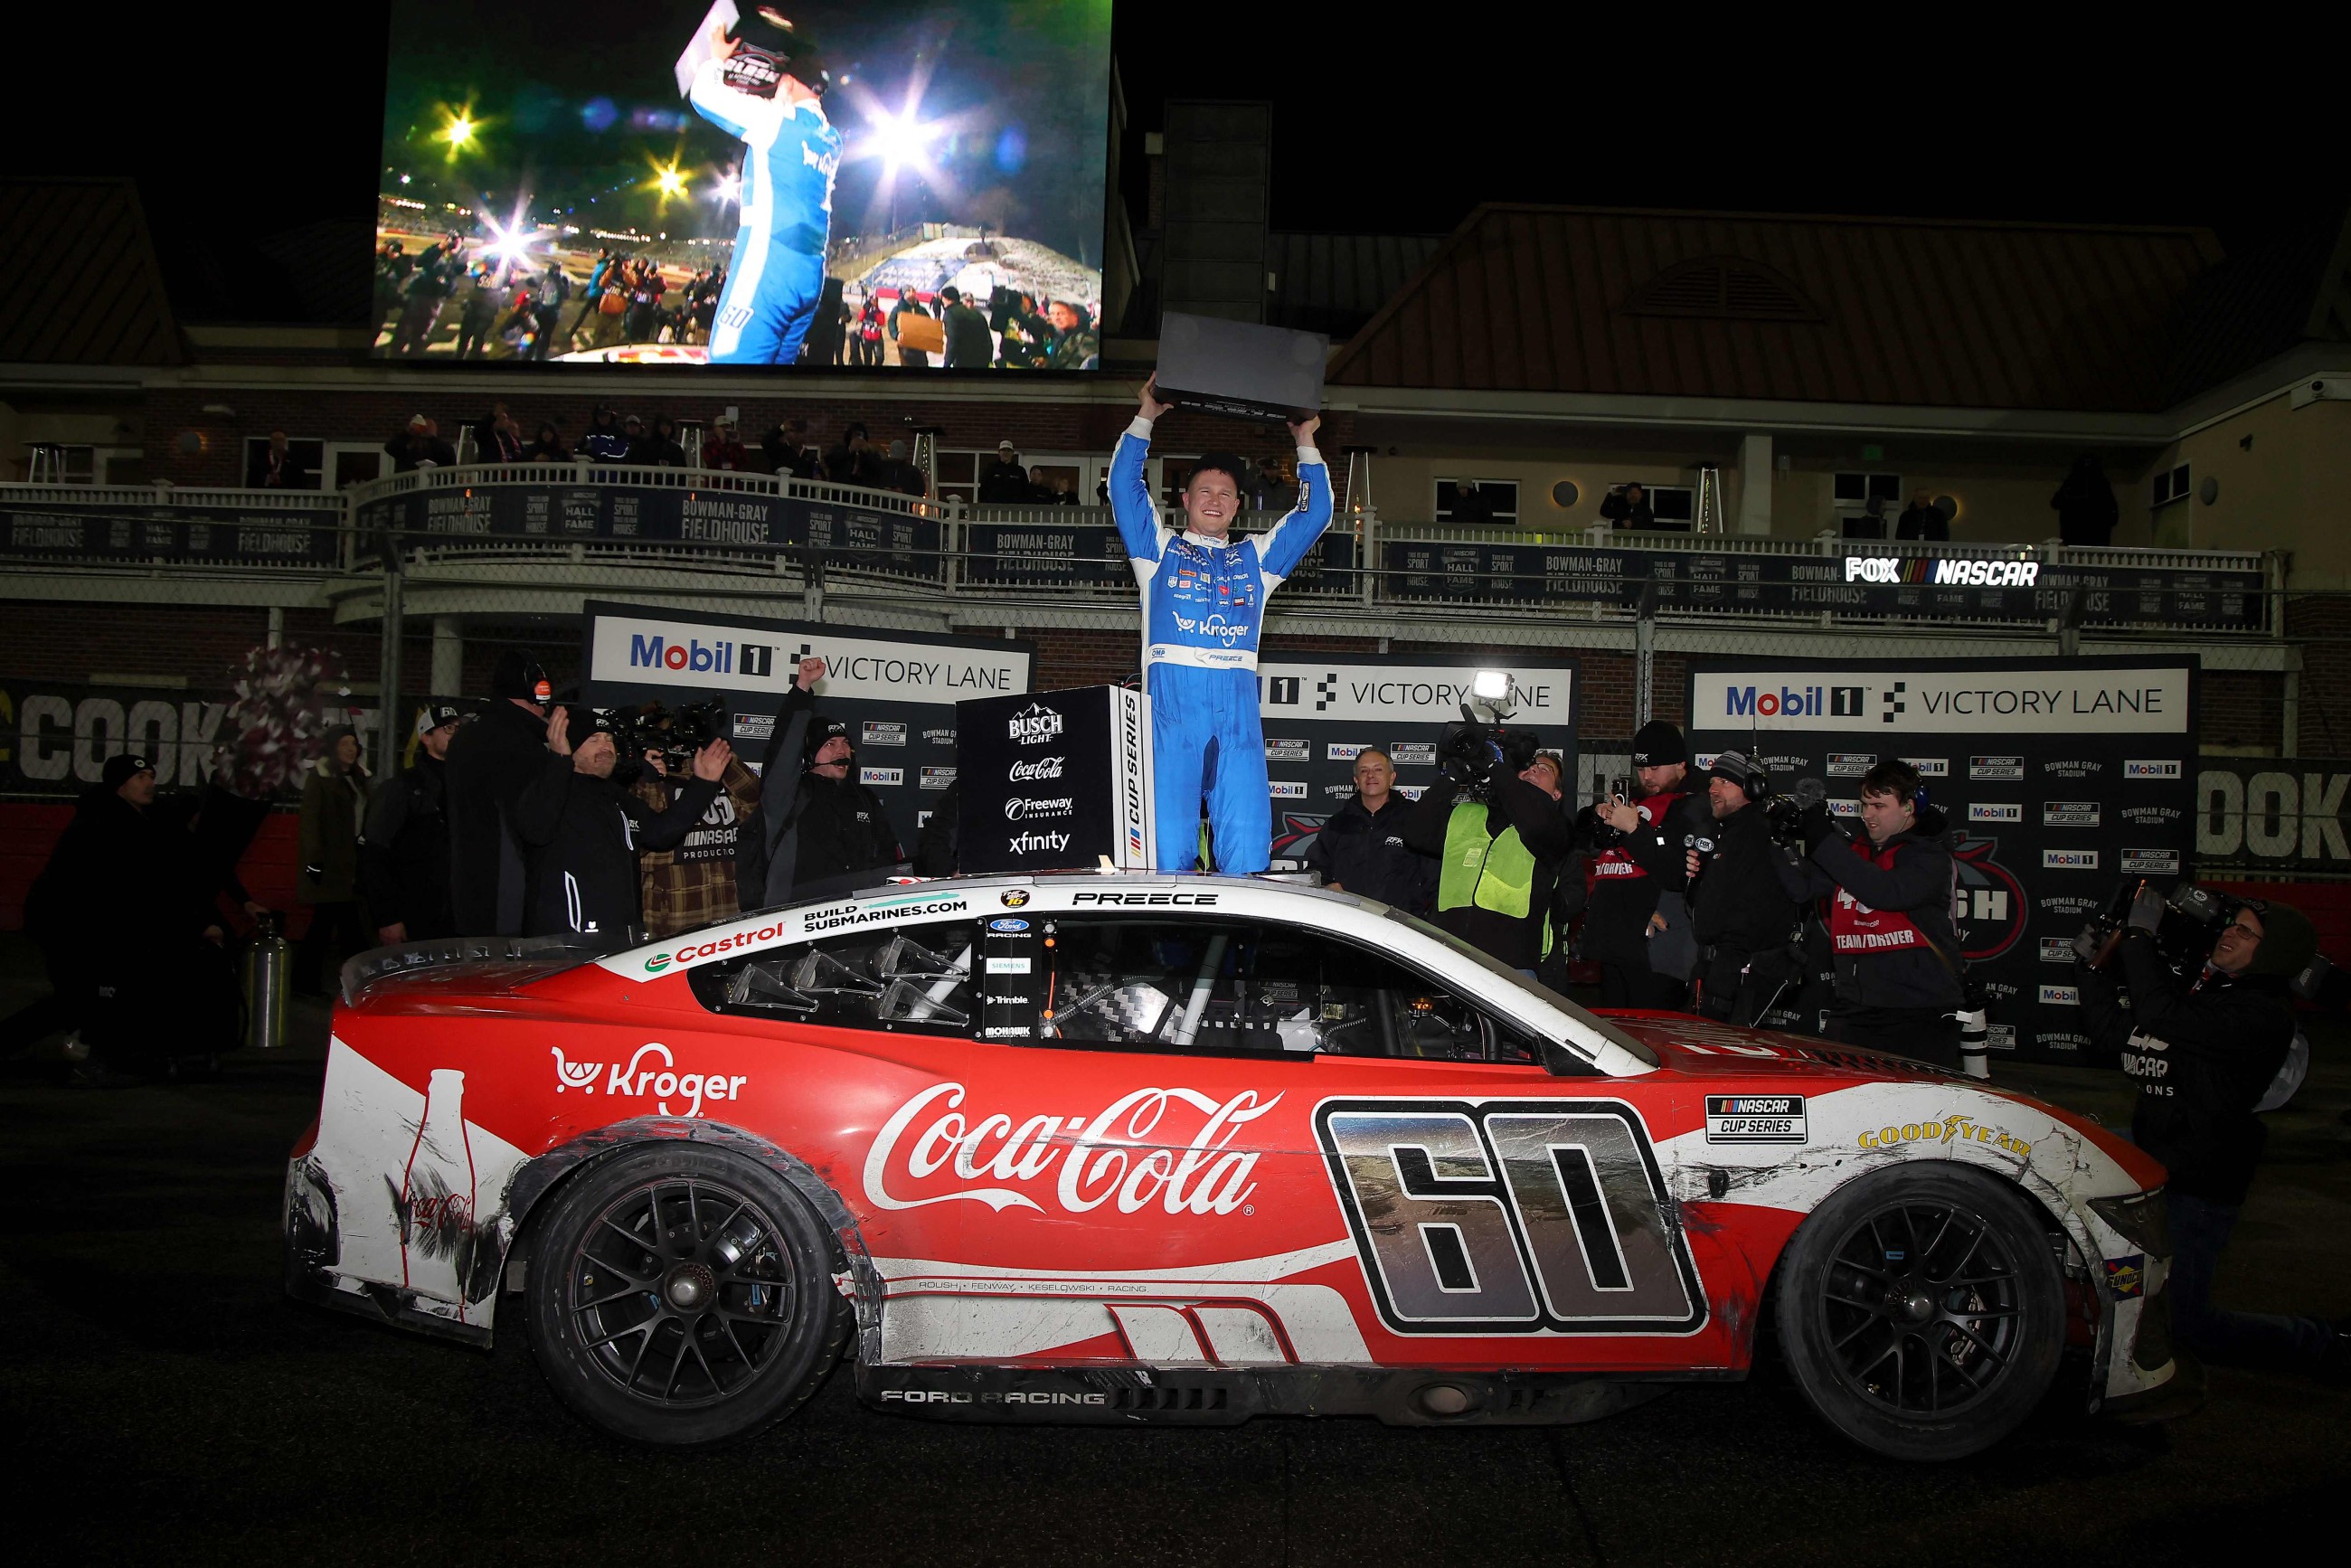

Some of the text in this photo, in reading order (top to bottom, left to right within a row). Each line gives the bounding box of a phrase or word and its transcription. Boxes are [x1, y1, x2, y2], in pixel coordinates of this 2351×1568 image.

[724, 58, 779, 83] CLASH
[427, 494, 491, 515] BOWMAN-GRAY
[614, 504, 637, 515] SPORT
[565, 506, 595, 516] HALL
[682, 499, 769, 522] BOWMAN-GRAY
[427, 514, 491, 534] FIELDHOUSE
[564, 520, 594, 530] FAME
[809, 519, 832, 532] SPORT
[681, 517, 769, 543] FIELDHOUSE
[849, 529, 877, 541] HALL
[239, 533, 311, 553] FIELDHOUSE
[892, 531, 912, 544] SPORT
[996, 534, 1075, 551] BOWMAN-GRAY
[848, 541, 877, 549] FAME
[996, 551, 1074, 572] FIELDHOUSE
[1407, 558, 1429, 569] SPORT
[1491, 561, 1514, 571] SPORT
[1545, 555, 1623, 574] BOWMAN-GRAY
[1447, 563, 1475, 573] HALL
[1654, 568, 1676, 579] SPORT
[1845, 556, 2039, 588] FOX NASCAR
[1407, 575, 1429, 587] HOUSE
[1447, 575, 1475, 584] FAME
[1693, 572, 1718, 581] HALL
[1738, 571, 1760, 581] SPORT
[1491, 579, 1513, 590] HOUSE
[1545, 572, 1623, 594] FIELDHOUSE
[1693, 584, 1721, 594] FAME
[1791, 586, 1866, 605] FIELDHOUSE
[1936, 594, 1964, 603] FAME
[2178, 600, 2206, 610] FAME
[1199, 614, 1249, 647] Kroger
[630, 633, 732, 674] Mobil
[1151, 649, 1166, 657] OMP
[1208, 654, 1243, 662] PREECE
[825, 655, 1012, 690] VICTORY LANE
[1351, 682, 1469, 706] VICTORY
[1726, 686, 1823, 717] Mobil
[1921, 688, 2164, 714] VICTORY LANE
[749, 715, 776, 725] NASCAR
[740, 725, 752, 734] CUP
[875, 723, 901, 732] NASCAR
[1008, 713, 1063, 740] BUSCH
[868, 732, 901, 741] CUP SERIES
[922, 729, 949, 740] BOWMAN
[1021, 734, 1052, 745] LIGHT
[20, 694, 226, 788] COOK
[931, 736, 954, 745] STADIUM
[1279, 741, 1304, 749] NASCAR
[1331, 747, 1358, 757] Mobil
[1403, 744, 1430, 752] NASCAR
[1126, 694, 1141, 825] CUP SERIES
[1790, 757, 1808, 767] GRAY
[1842, 755, 1871, 764] NASCAR
[1987, 758, 2016, 766] NASCAR
[1009, 756, 1065, 782] Coca-Cola
[1770, 764, 1795, 772] STADIUM
[2044, 760, 2101, 772] BOWMAN GRAY
[2129, 763, 2163, 775] Mobil
[864, 770, 890, 781] Mobil
[933, 769, 957, 777] NASCAR
[1993, 768, 2016, 776] SERIES
[2057, 769, 2086, 778] STADIUM
[926, 778, 939, 786] CUP
[1270, 784, 1293, 794] Mobil
[1325, 784, 1354, 795] BOWMAN
[1024, 798, 1073, 812] Freeway
[1830, 802, 1859, 813] Mobil
[2063, 803, 2091, 812] NASCAR
[1024, 809, 1072, 818] INSURANCE
[1973, 807, 2005, 817] Mobil
[2122, 807, 2181, 819] BOWMAN GRAY
[2052, 814, 2091, 822] CUP SERIES
[2135, 816, 2165, 824] STADIUM
[1009, 830, 1071, 855] xfinity
[1699, 839, 1711, 848] FOX
[2047, 853, 2081, 864] Mobil
[2139, 851, 2171, 859] NASCAR
[2129, 861, 2171, 869] CUP SERIES
[1007, 898, 1024, 906] 16
[1072, 893, 1219, 905] PREECE
[2041, 897, 2098, 909] BOWMAN GRAY
[804, 904, 858, 921] BUILD
[2054, 905, 2082, 914] STADIUM
[804, 901, 968, 932] SUBMARINES.COM
[997, 921, 1021, 930] Ford
[675, 921, 785, 963] Castrol
[1836, 929, 1915, 950] TEAM/DRIVER
[2048, 949, 2063, 958] CUP
[1999, 984, 2018, 995] GRAY
[2044, 989, 2076, 1001] Mobil
[996, 996, 1029, 1004] Trimble
[1782, 1010, 1801, 1021] GRAY
[985, 1026, 1031, 1035] MOHAWK
[2036, 1033, 2069, 1044] BOWMAN
[2049, 1042, 2077, 1051] STADIUM
[606, 1043, 747, 1119] Kroger
[1738, 1099, 1790, 1114] NASCAR
[1720, 1119, 1792, 1133] CUP SERIES
[1857, 1116, 2033, 1157] GOODYEAR
[863, 1082, 1286, 1216] Coca-Cola
[1310, 1095, 1710, 1338] 60
[919, 1280, 1147, 1293] ROUSH FENWAY KESELOWSKI RACING
[881, 1389, 973, 1403] FORD
